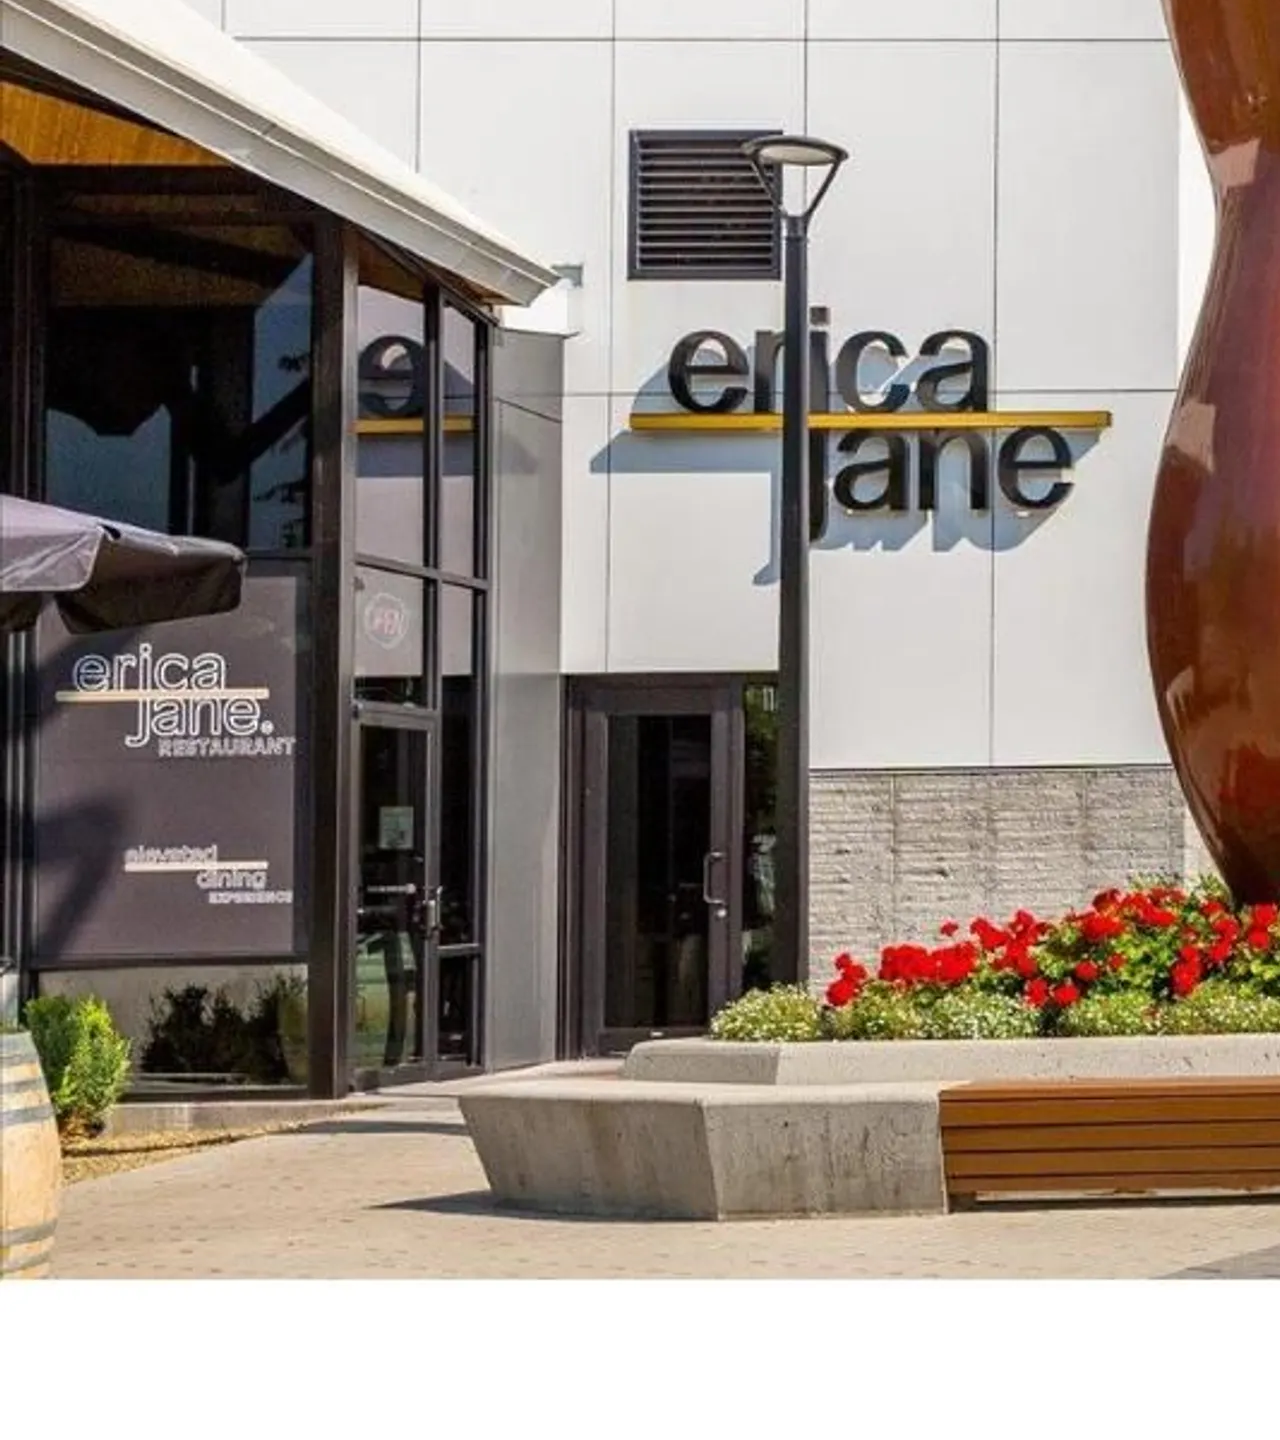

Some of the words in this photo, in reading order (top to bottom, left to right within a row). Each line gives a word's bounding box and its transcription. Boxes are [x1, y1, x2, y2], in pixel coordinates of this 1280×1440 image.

[667, 306, 989, 414] erica
[72, 643, 227, 692] erica
[157, 736, 296, 758] RESTAURANT
